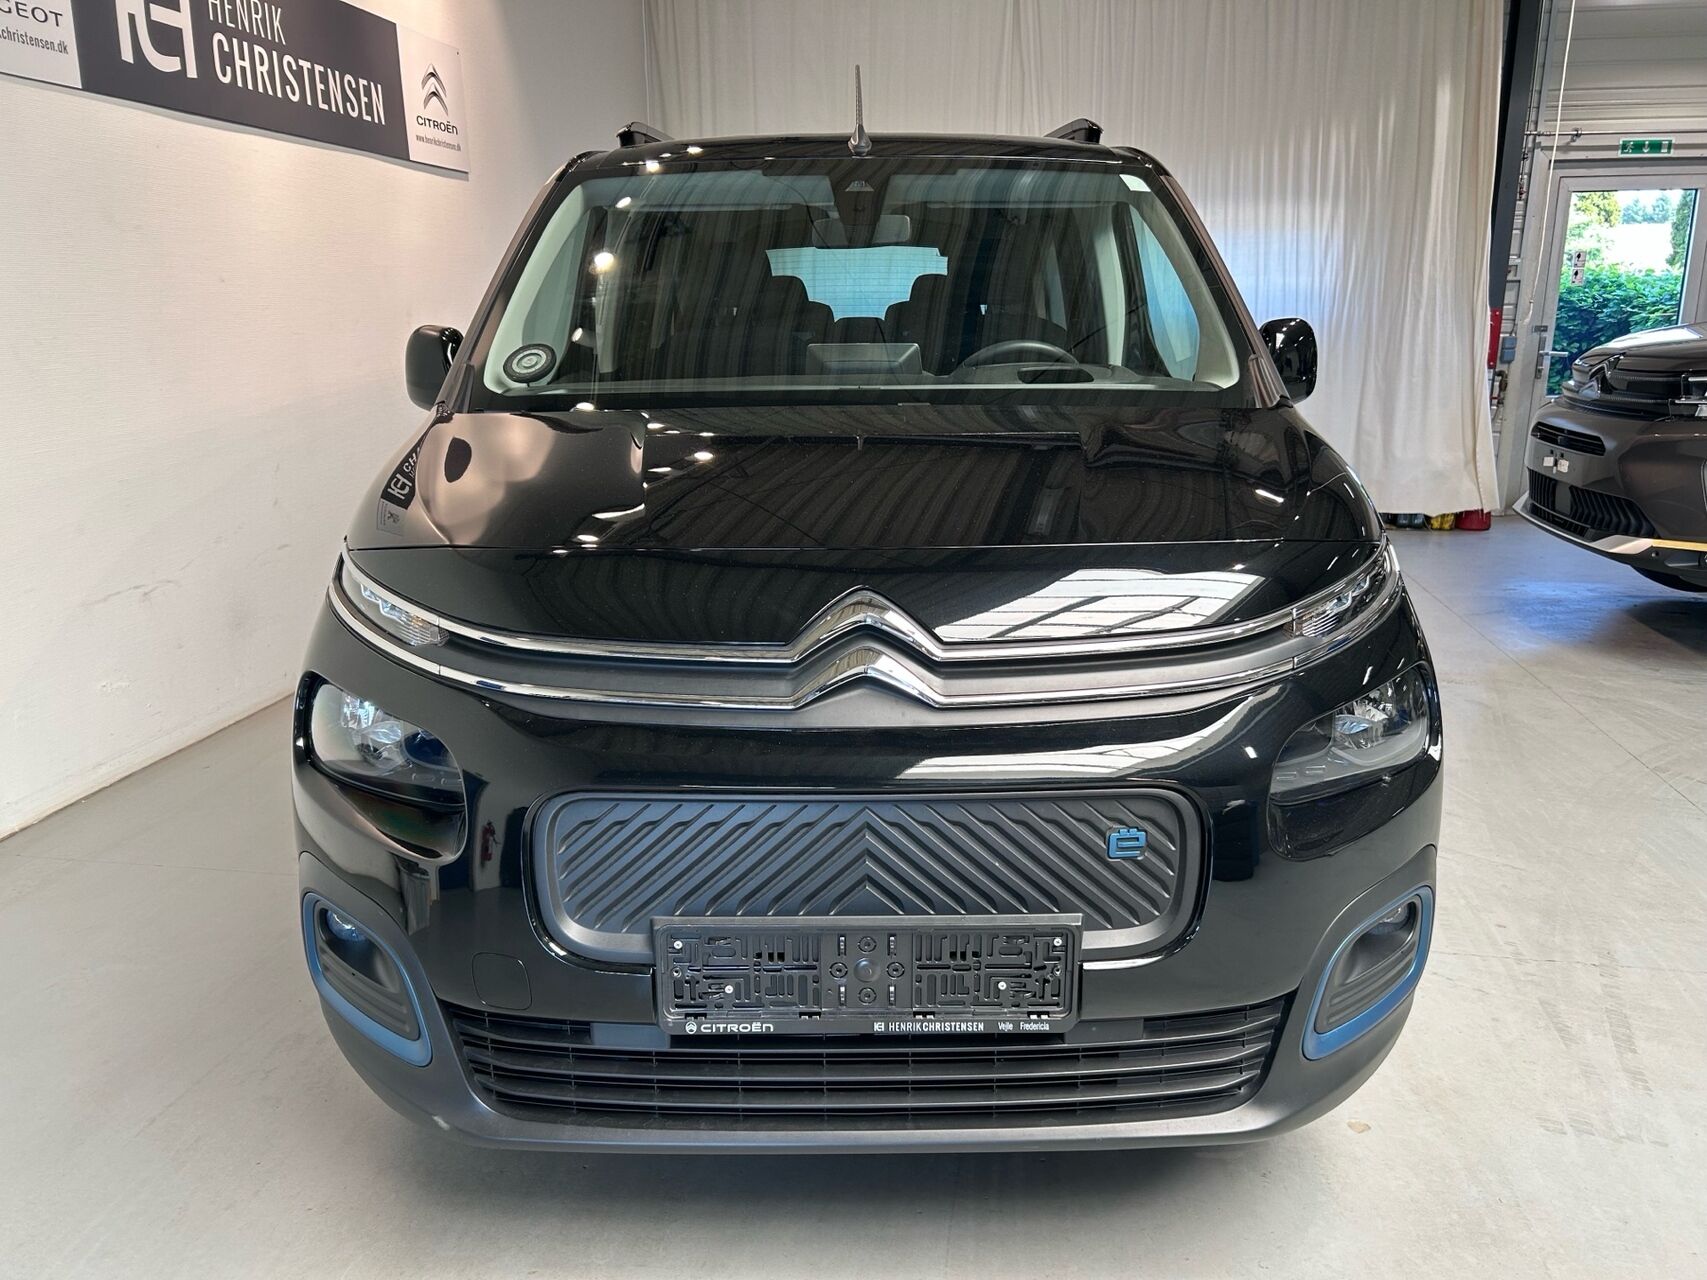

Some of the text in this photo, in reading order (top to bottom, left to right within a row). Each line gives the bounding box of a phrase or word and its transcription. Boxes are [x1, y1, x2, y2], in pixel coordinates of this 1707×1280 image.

[0, 26, 69, 55] christensen.dk
[208, 0, 286, 45] HENRIK
[212, 32, 386, 125] CHRISTENSEN
[997, 1022, 1014, 1032] Vejle
[1020, 1021, 1050, 1031] Fredericia
